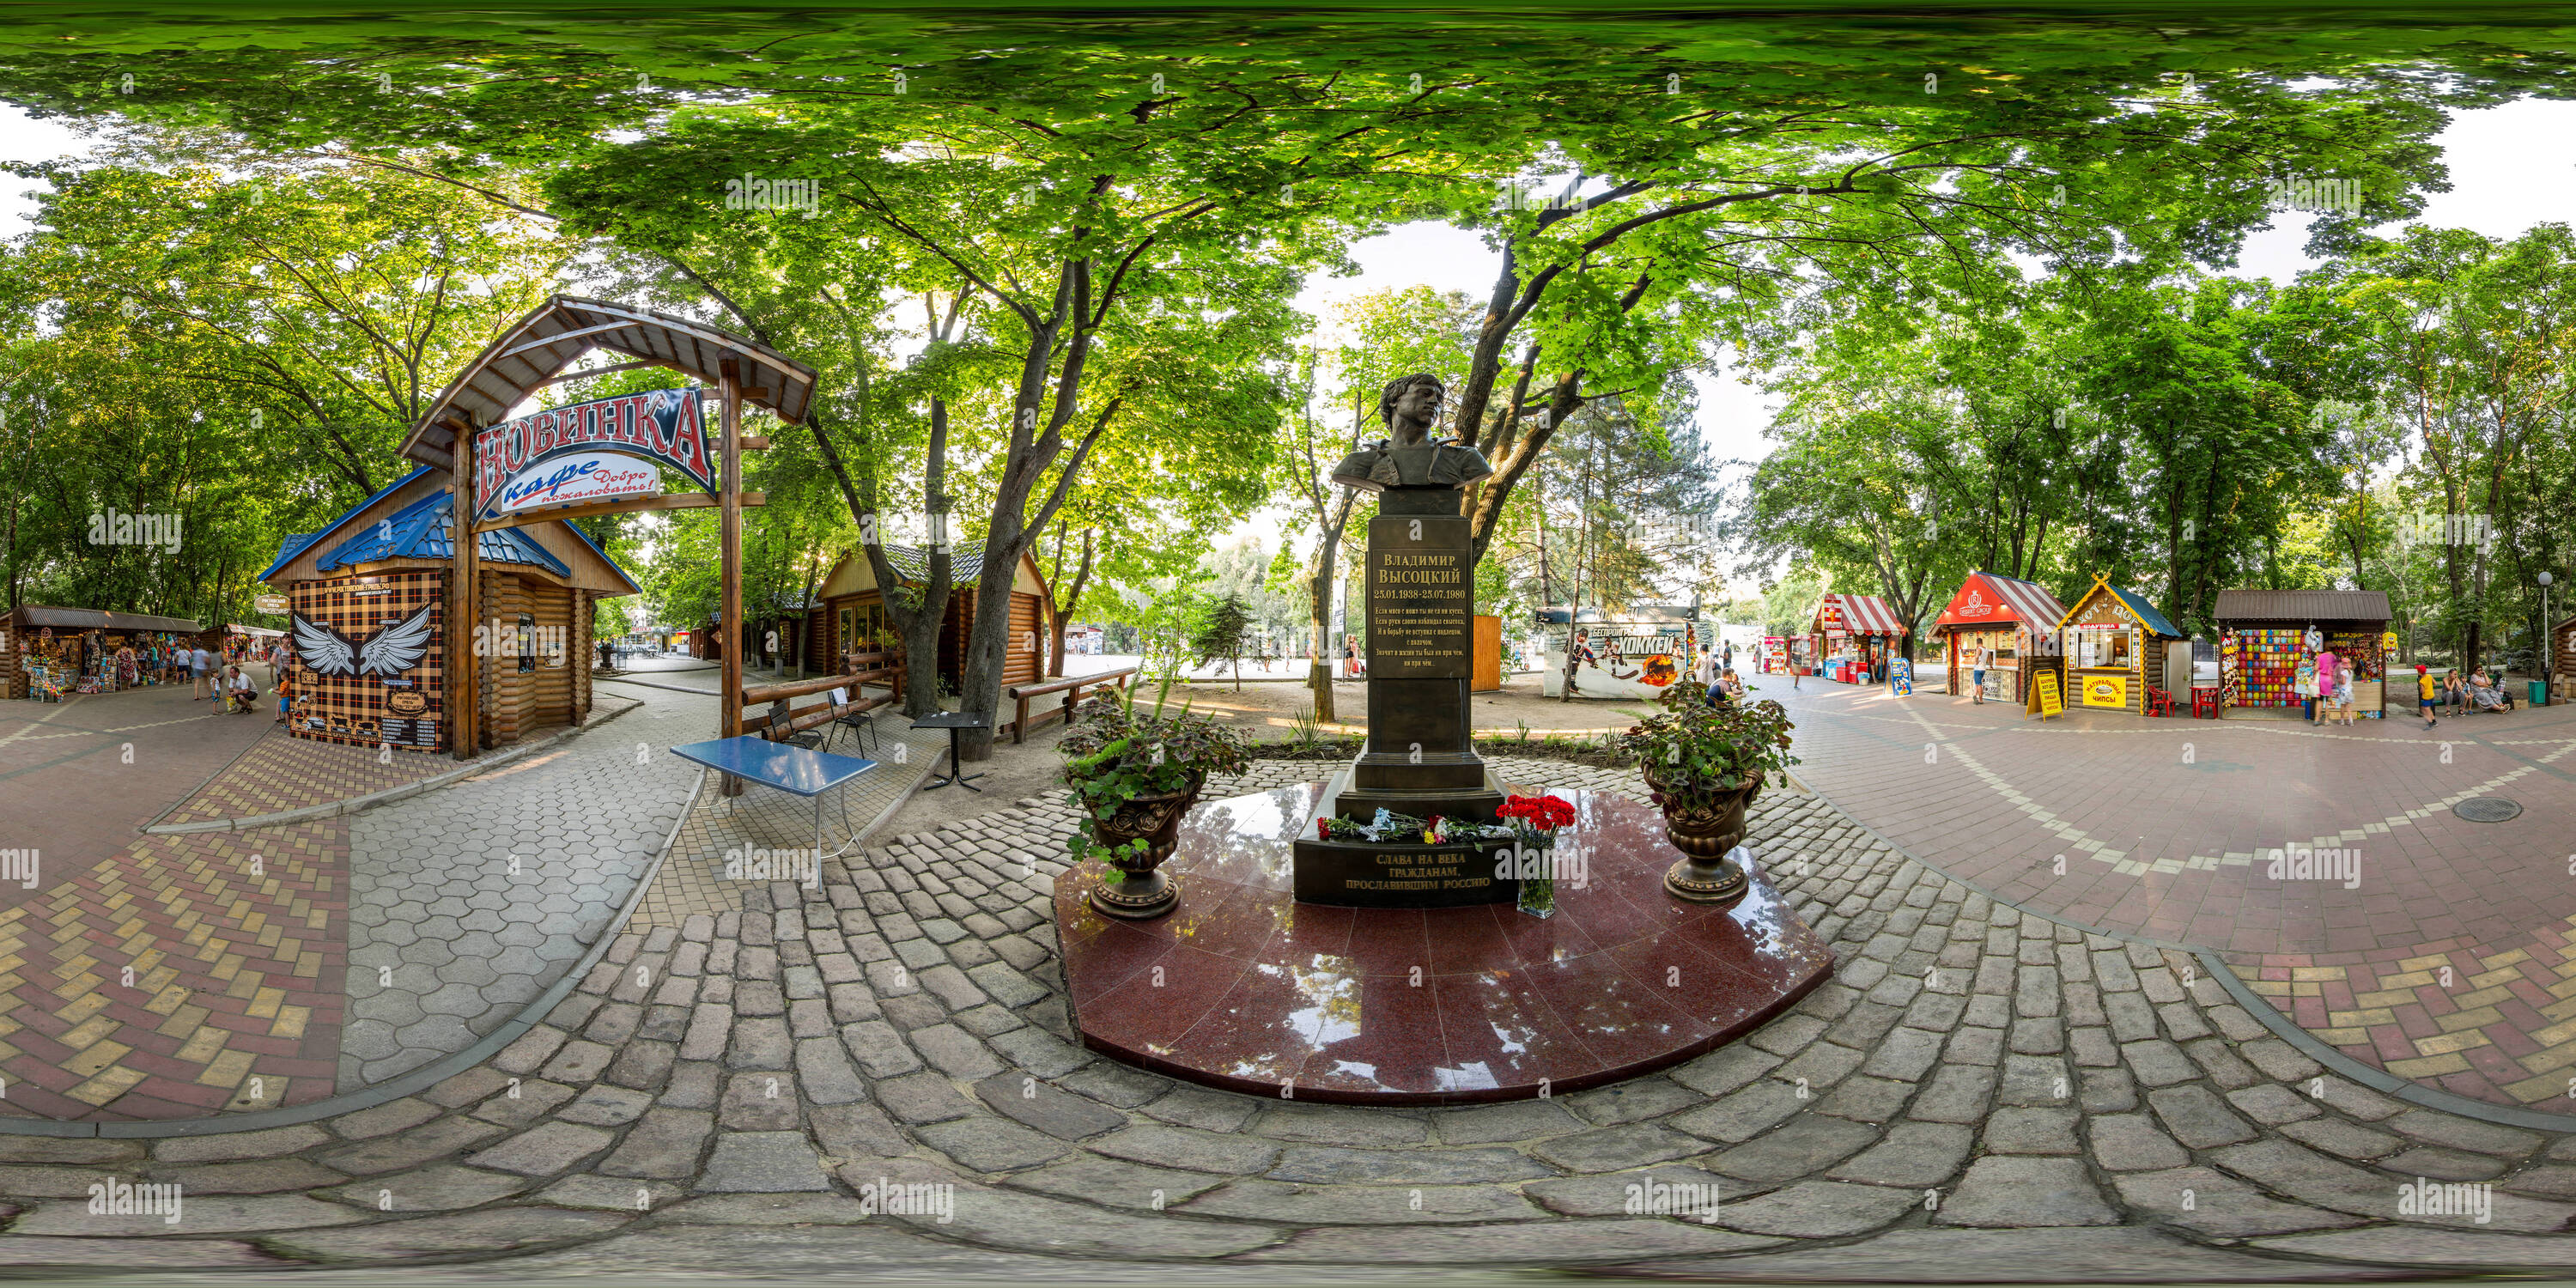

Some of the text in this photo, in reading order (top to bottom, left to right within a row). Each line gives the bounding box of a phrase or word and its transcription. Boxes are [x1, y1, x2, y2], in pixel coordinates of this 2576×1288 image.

[476, 390, 711, 516] НОВИНКА
[504, 460, 601, 504] кафе
[592, 469, 648, 486] Добро
[541, 479, 655, 504] пожаловать!
[1379, 567, 1461, 586] ВЫСОЦКИЙ
[1374, 589, 1465, 599] 25.01.1938-25.07.1980
[2077, 603, 2139, 625] ХОТ ДОГ
[1387, 628, 1404, 637] борьбу
[1617, 632, 1674, 654] ХОККЕЙ
[2087, 680, 2122, 695] НАТУРАЛЬНЫЕ
[1376, 854, 1466, 864] СЛАВА НА ВЕКА
[1346, 878, 1490, 890] ПРОСЛАВИВШИМ РОССИЮ
